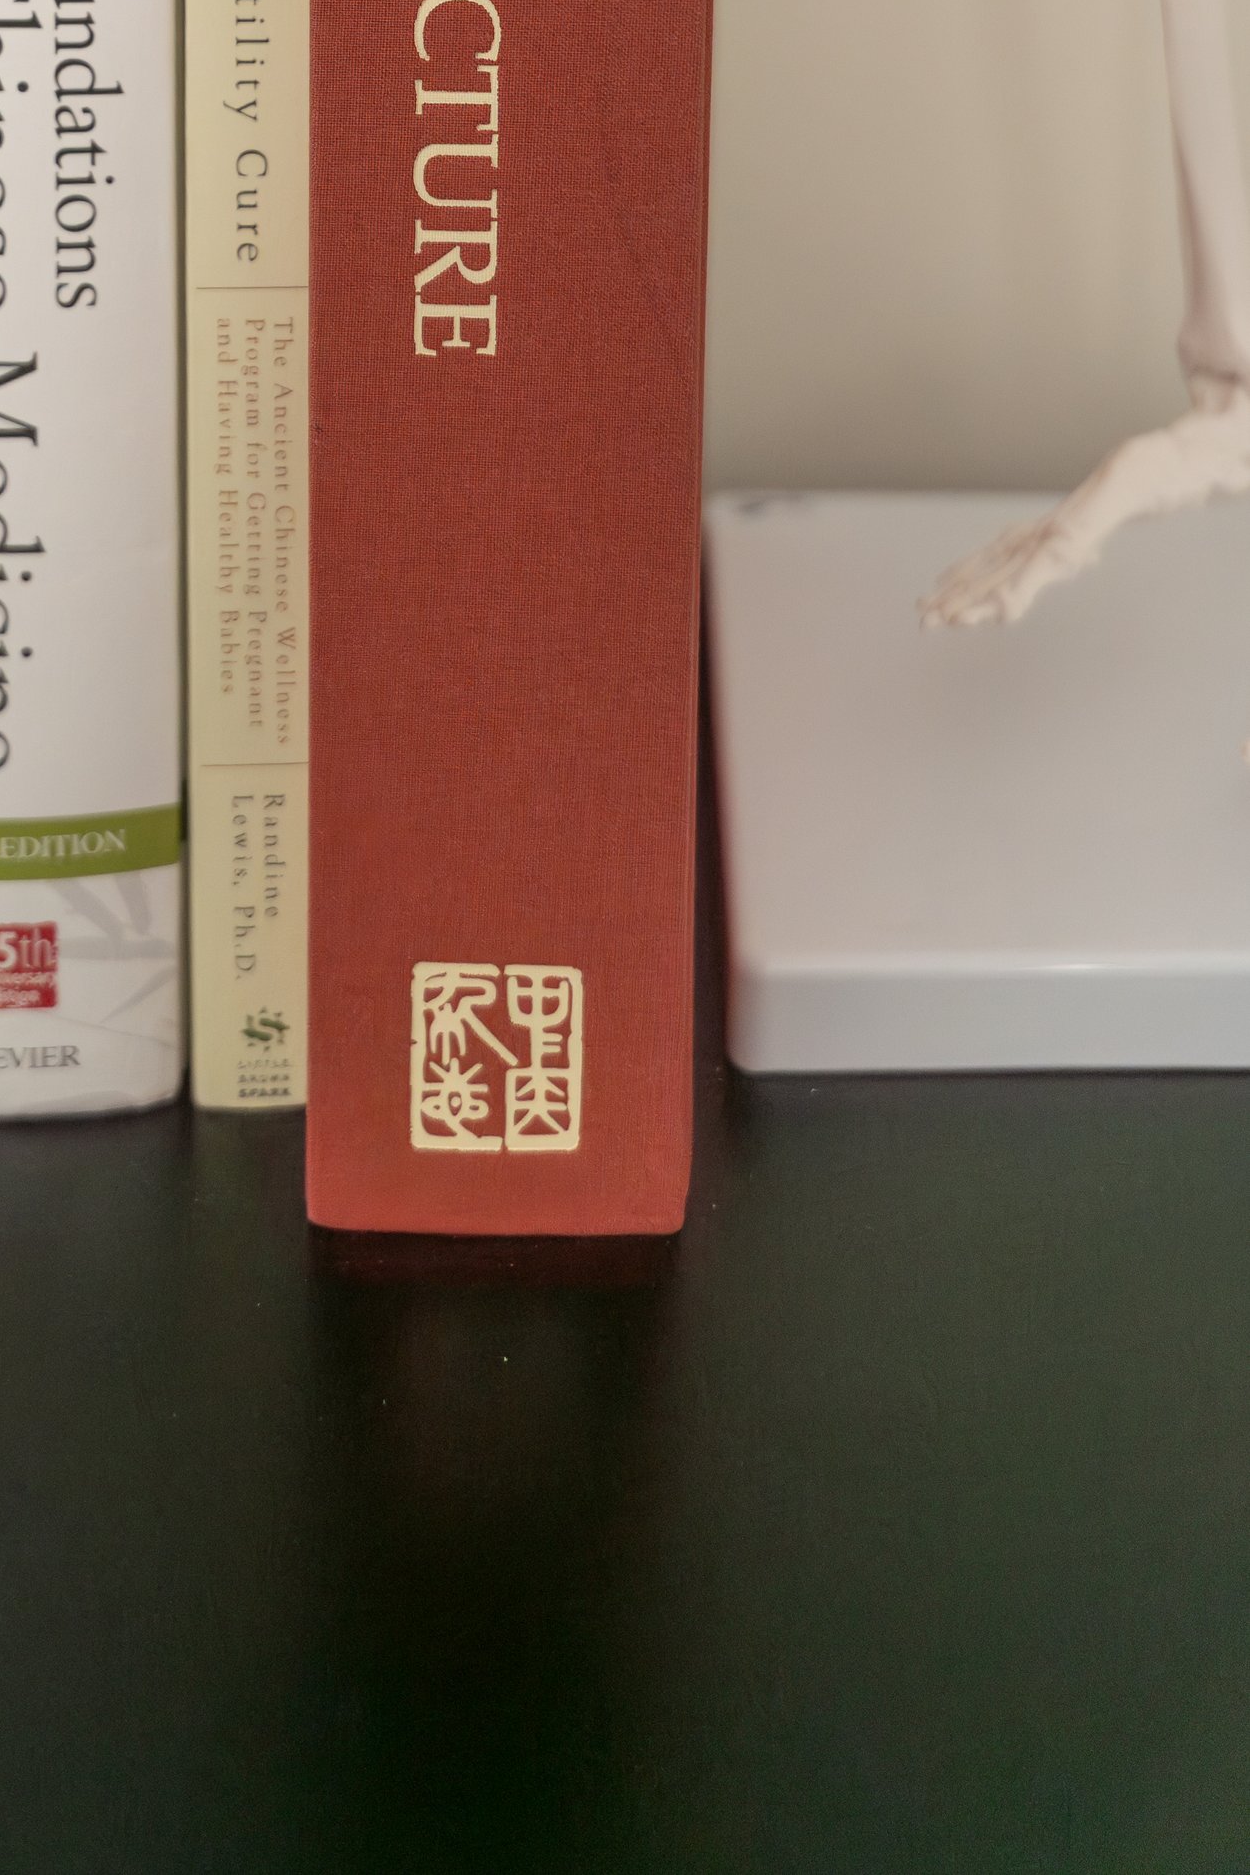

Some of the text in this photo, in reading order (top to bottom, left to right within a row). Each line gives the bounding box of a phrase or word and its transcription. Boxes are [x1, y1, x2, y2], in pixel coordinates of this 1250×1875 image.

[235, 148, 269, 263] Cure
[214, 317, 241, 694] and Having Healthy Babies
[240, 318, 269, 727] Program for Getting Pregnant
[273, 316, 297, 745] The Ancient Chinese Wellness
[232, 794, 257, 981] Lewis, Ph.D.
[263, 792, 287, 919] Randine
